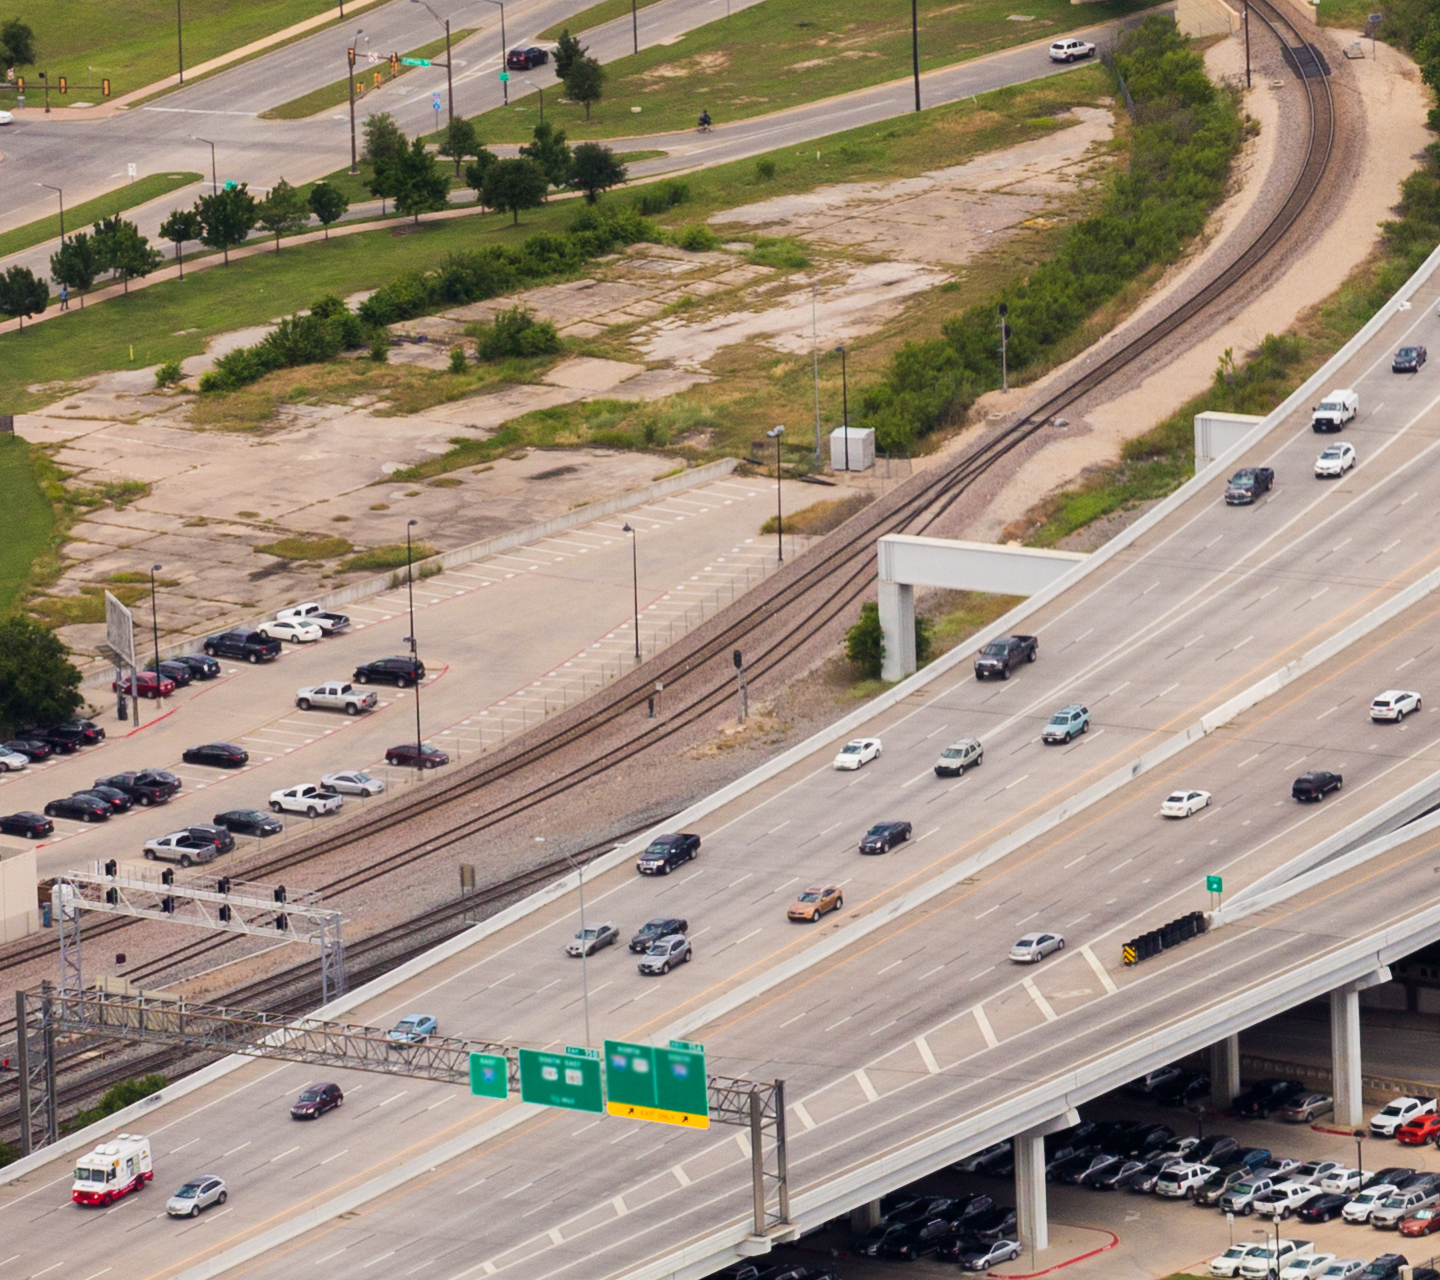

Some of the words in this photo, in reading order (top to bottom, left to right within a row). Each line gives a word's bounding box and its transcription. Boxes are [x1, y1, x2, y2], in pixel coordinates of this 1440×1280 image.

[564, 1059, 581, 1068] EAST
[641, 1109, 654, 1117] EXIT
[658, 1112, 675, 1120] ONLY
